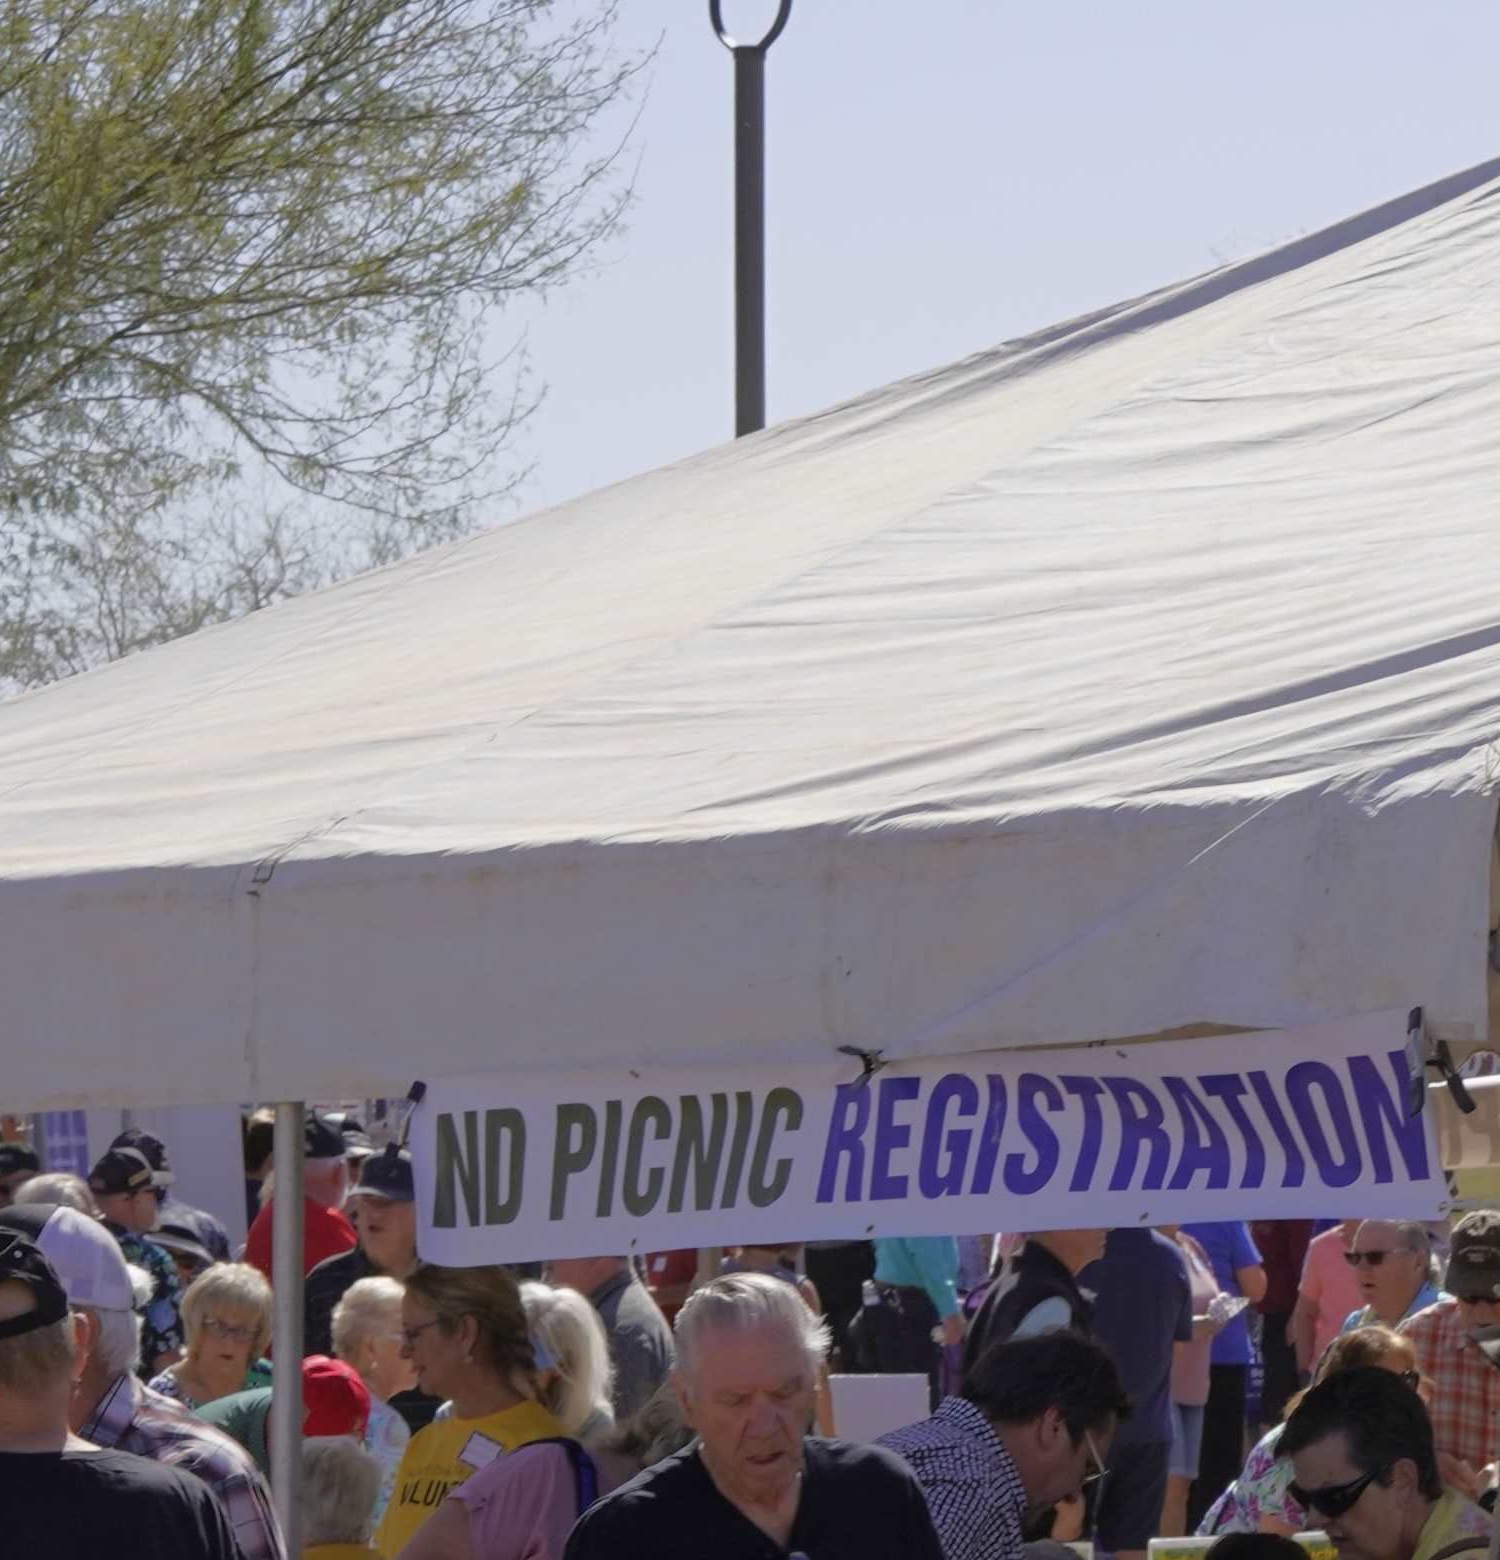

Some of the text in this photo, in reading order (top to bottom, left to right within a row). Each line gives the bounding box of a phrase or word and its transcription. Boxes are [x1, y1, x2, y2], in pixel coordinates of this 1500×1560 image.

[432, 1108, 527, 1229] ND
[549, 1087, 803, 1221] PICNIC
[815, 1050, 1430, 1204] REGISTRATION
